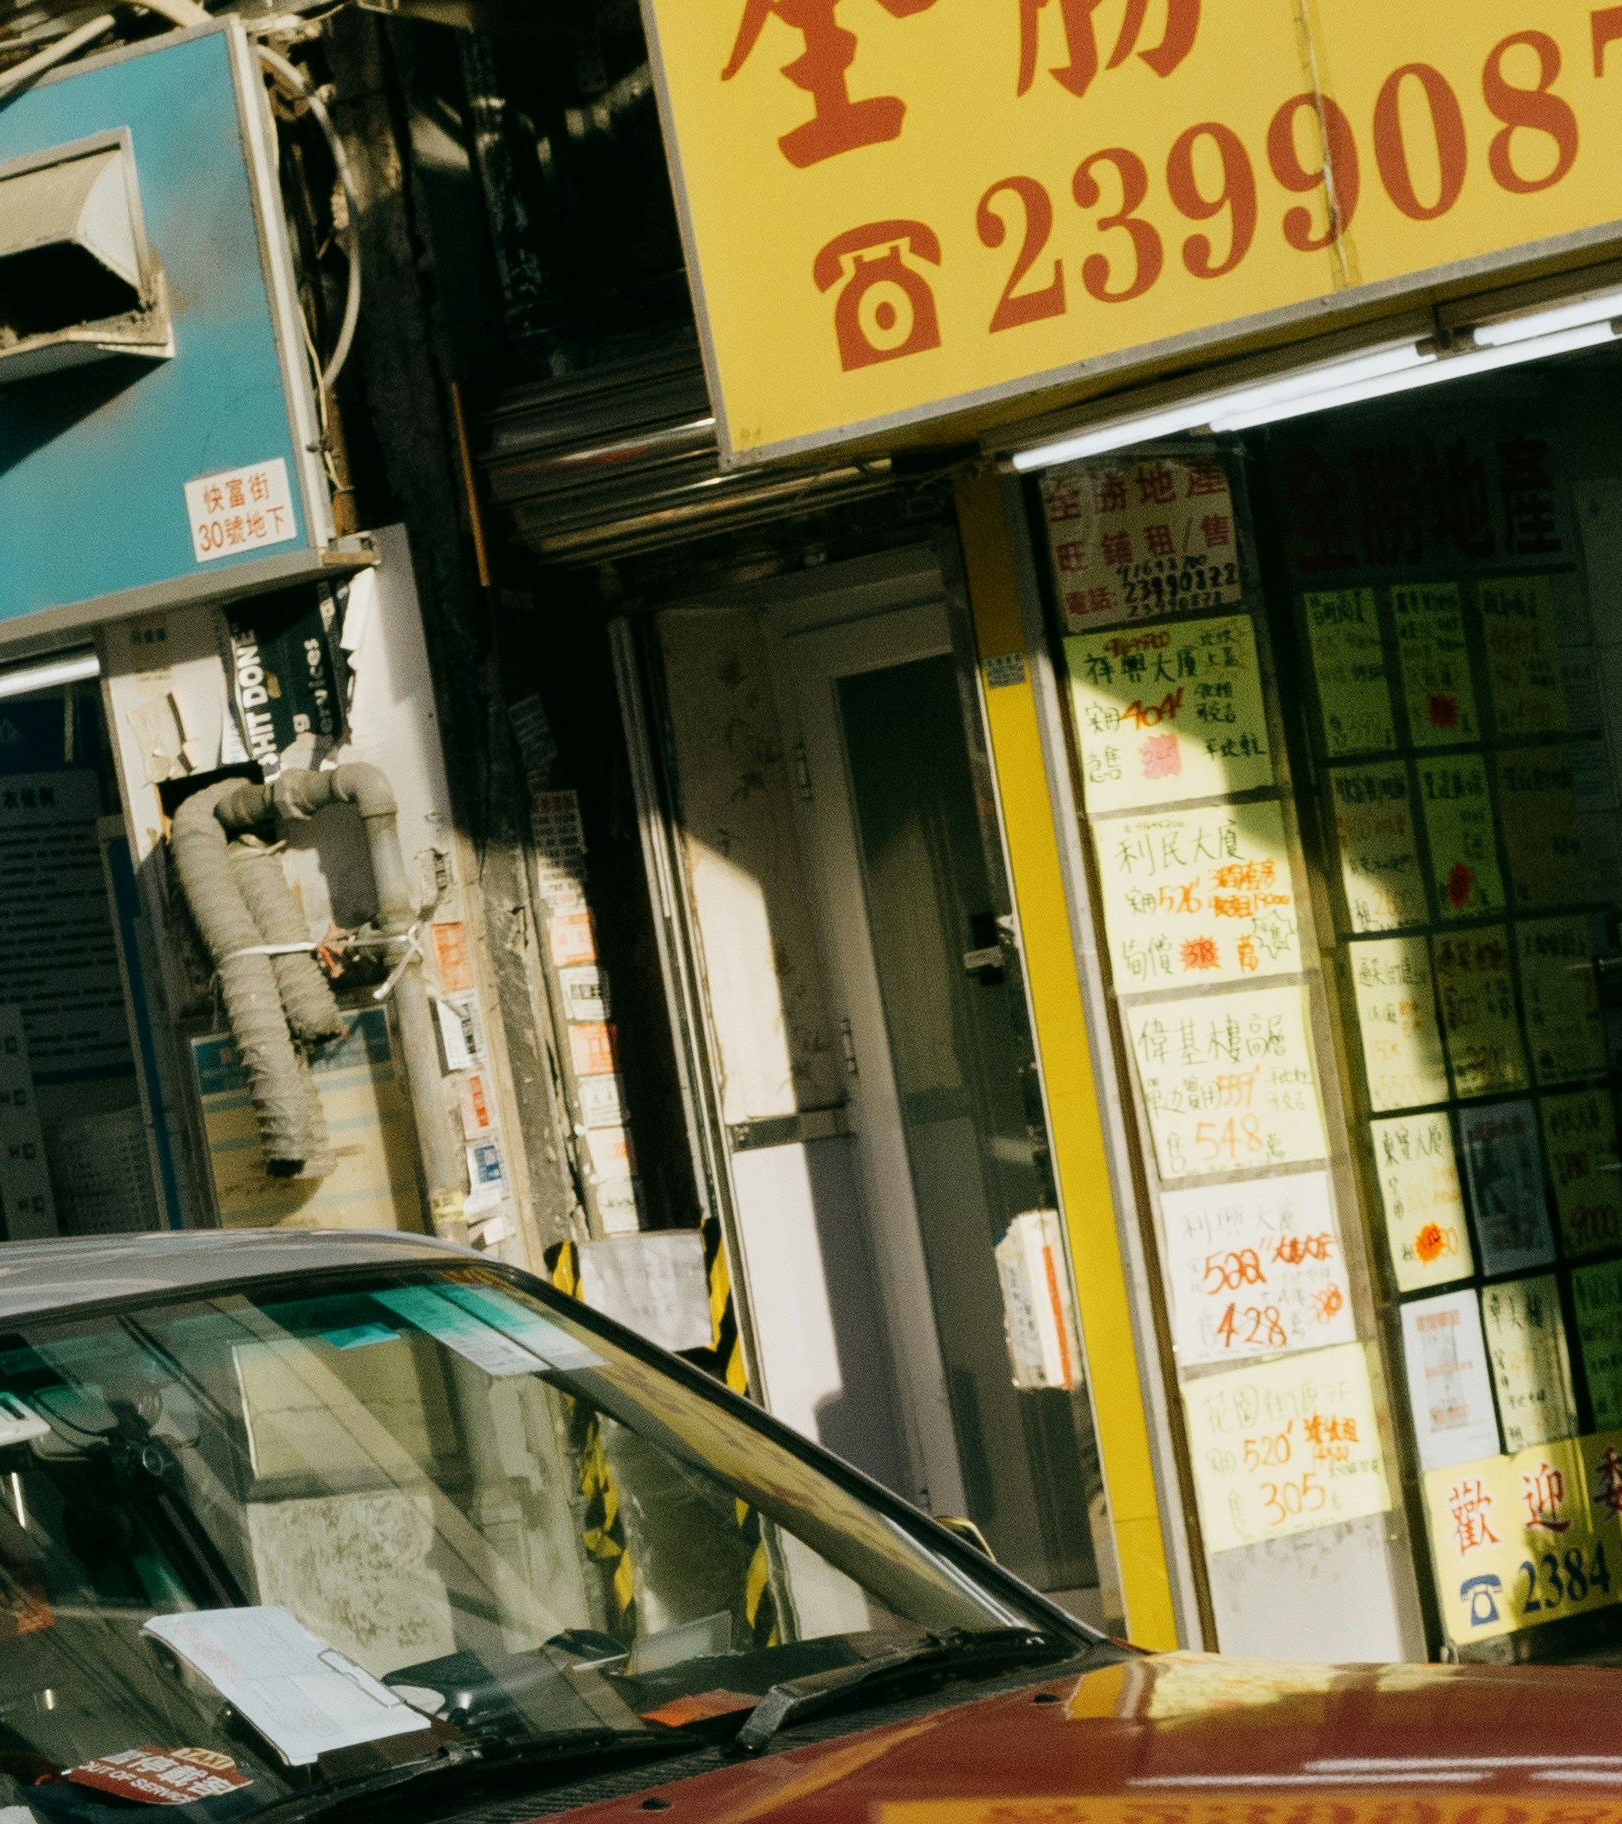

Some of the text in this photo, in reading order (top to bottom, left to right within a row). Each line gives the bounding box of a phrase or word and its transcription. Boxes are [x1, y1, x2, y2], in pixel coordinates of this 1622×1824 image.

[202, 472, 272, 512] 快富街
[198, 507, 286, 553] 30號地下
[1194, 1112, 1264, 1162] 548
[1217, 1301, 1288, 1348] 428
[1260, 1472, 1326, 1527] 305
[1519, 1542, 1612, 1615] 2384
